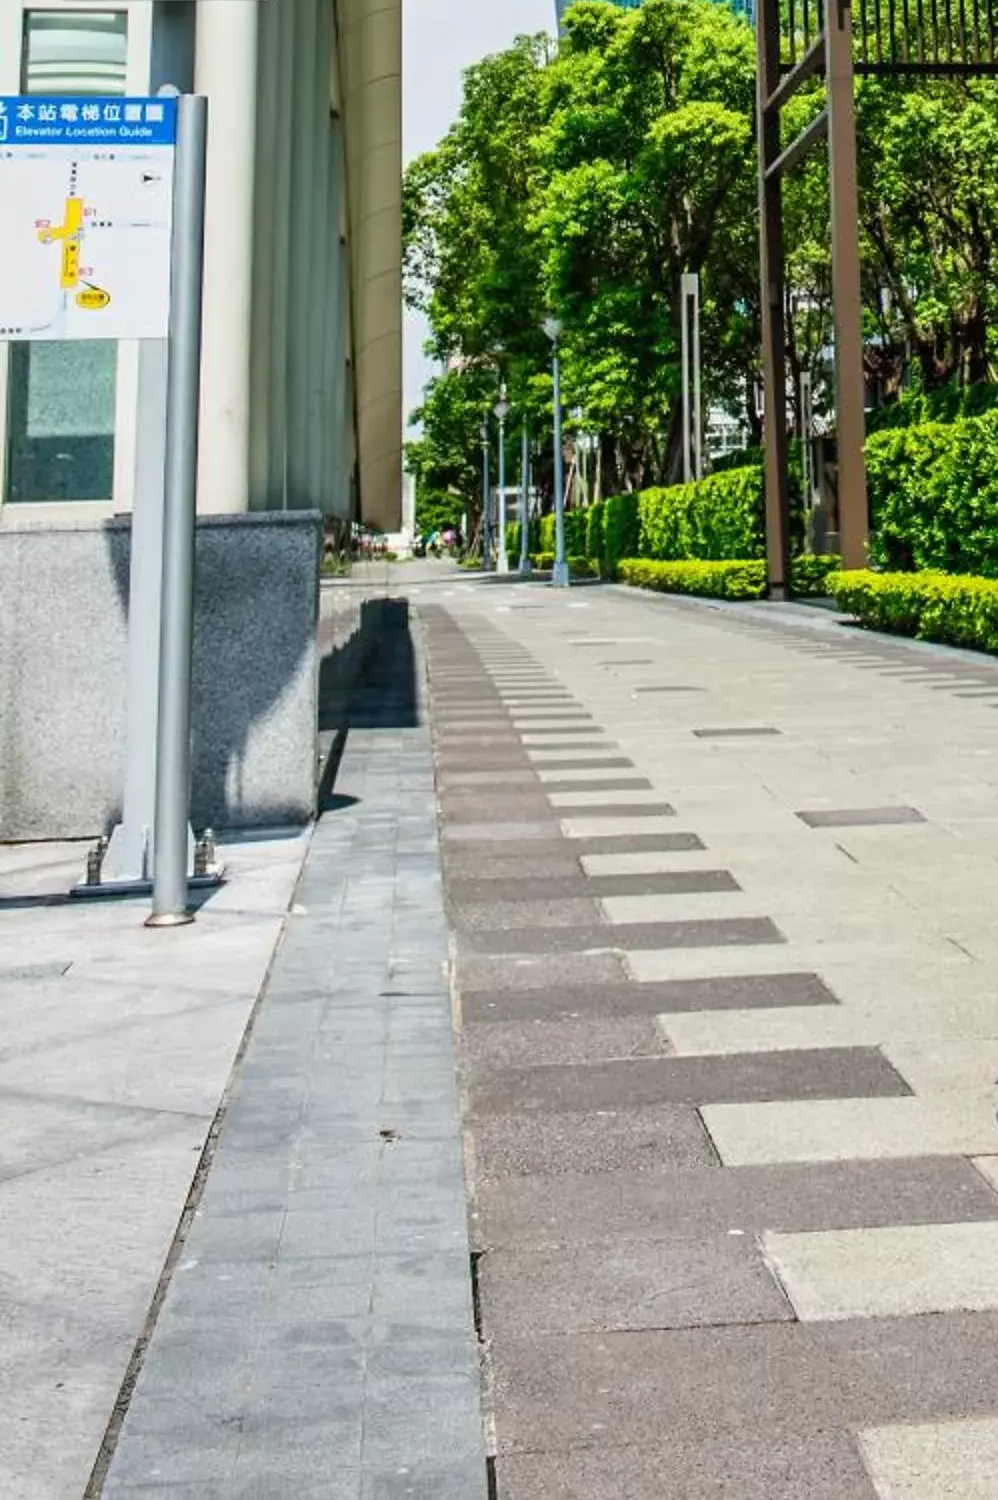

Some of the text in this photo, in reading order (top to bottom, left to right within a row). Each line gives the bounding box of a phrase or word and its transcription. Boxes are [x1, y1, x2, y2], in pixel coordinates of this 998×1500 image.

[15, 125, 153, 137] Elevator Location Guide
